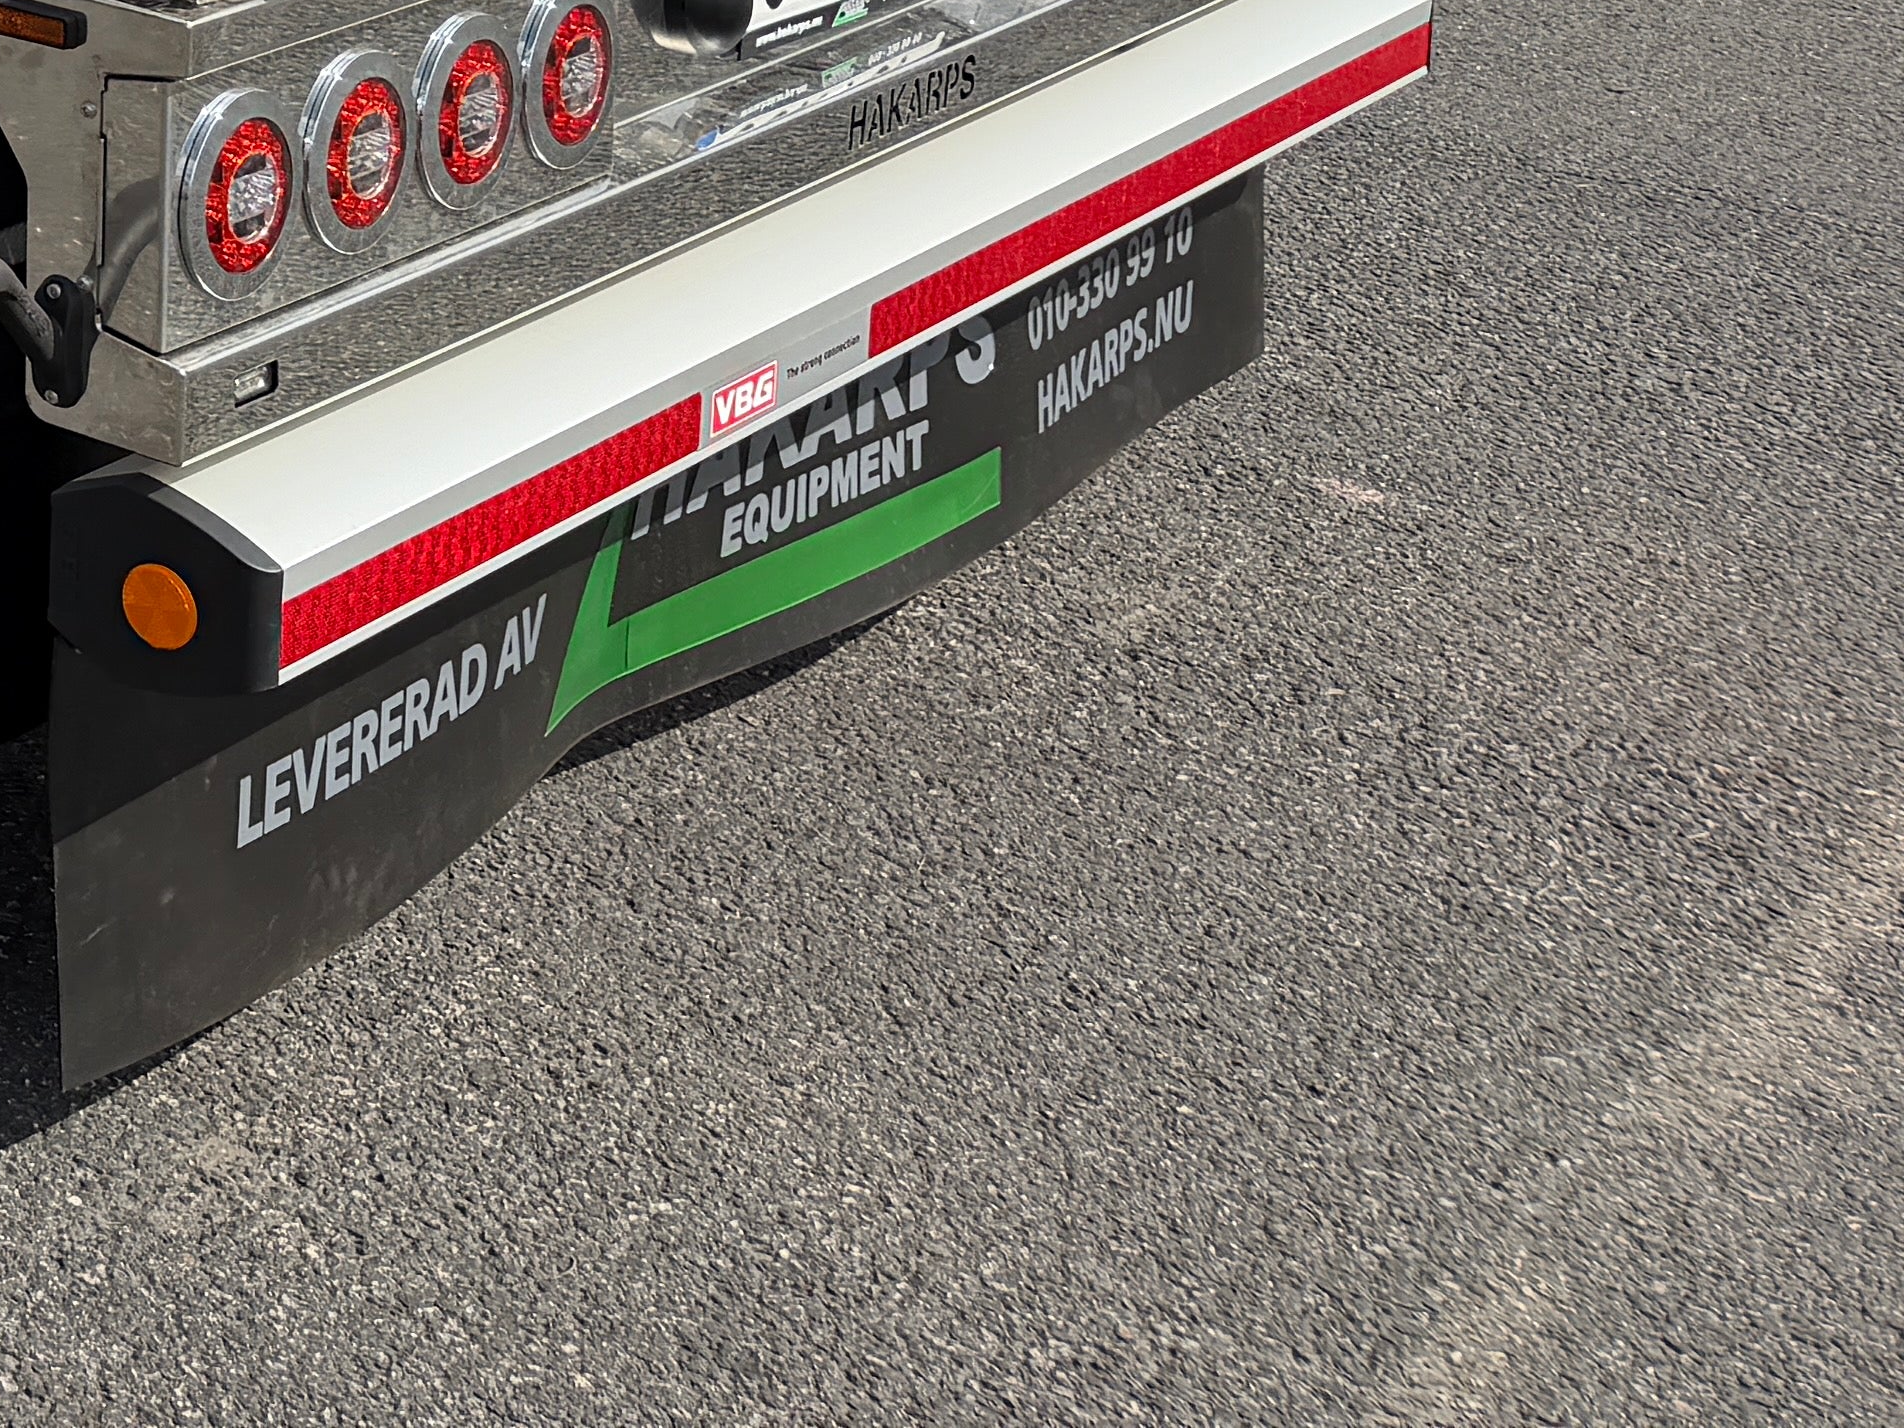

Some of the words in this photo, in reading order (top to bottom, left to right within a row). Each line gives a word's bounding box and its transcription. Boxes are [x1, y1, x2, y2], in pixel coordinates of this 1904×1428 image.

[847, 54, 977, 150] HAKARPS
[1027, 247, 1120, 351] 010-330
[1126, 226, 1155, 287] 99
[1164, 206, 1194, 264] 10
[715, 369, 774, 425] VBG
[786, 366, 799, 380] The
[800, 353, 823, 374] strong
[824, 334, 861, 361] connection
[1037, 279, 1194, 434] HAKARPS.NU
[720, 419, 930, 559] EQUIPMENT
[236, 643, 488, 849] LEVERERAD
[493, 592, 548, 691] AV
